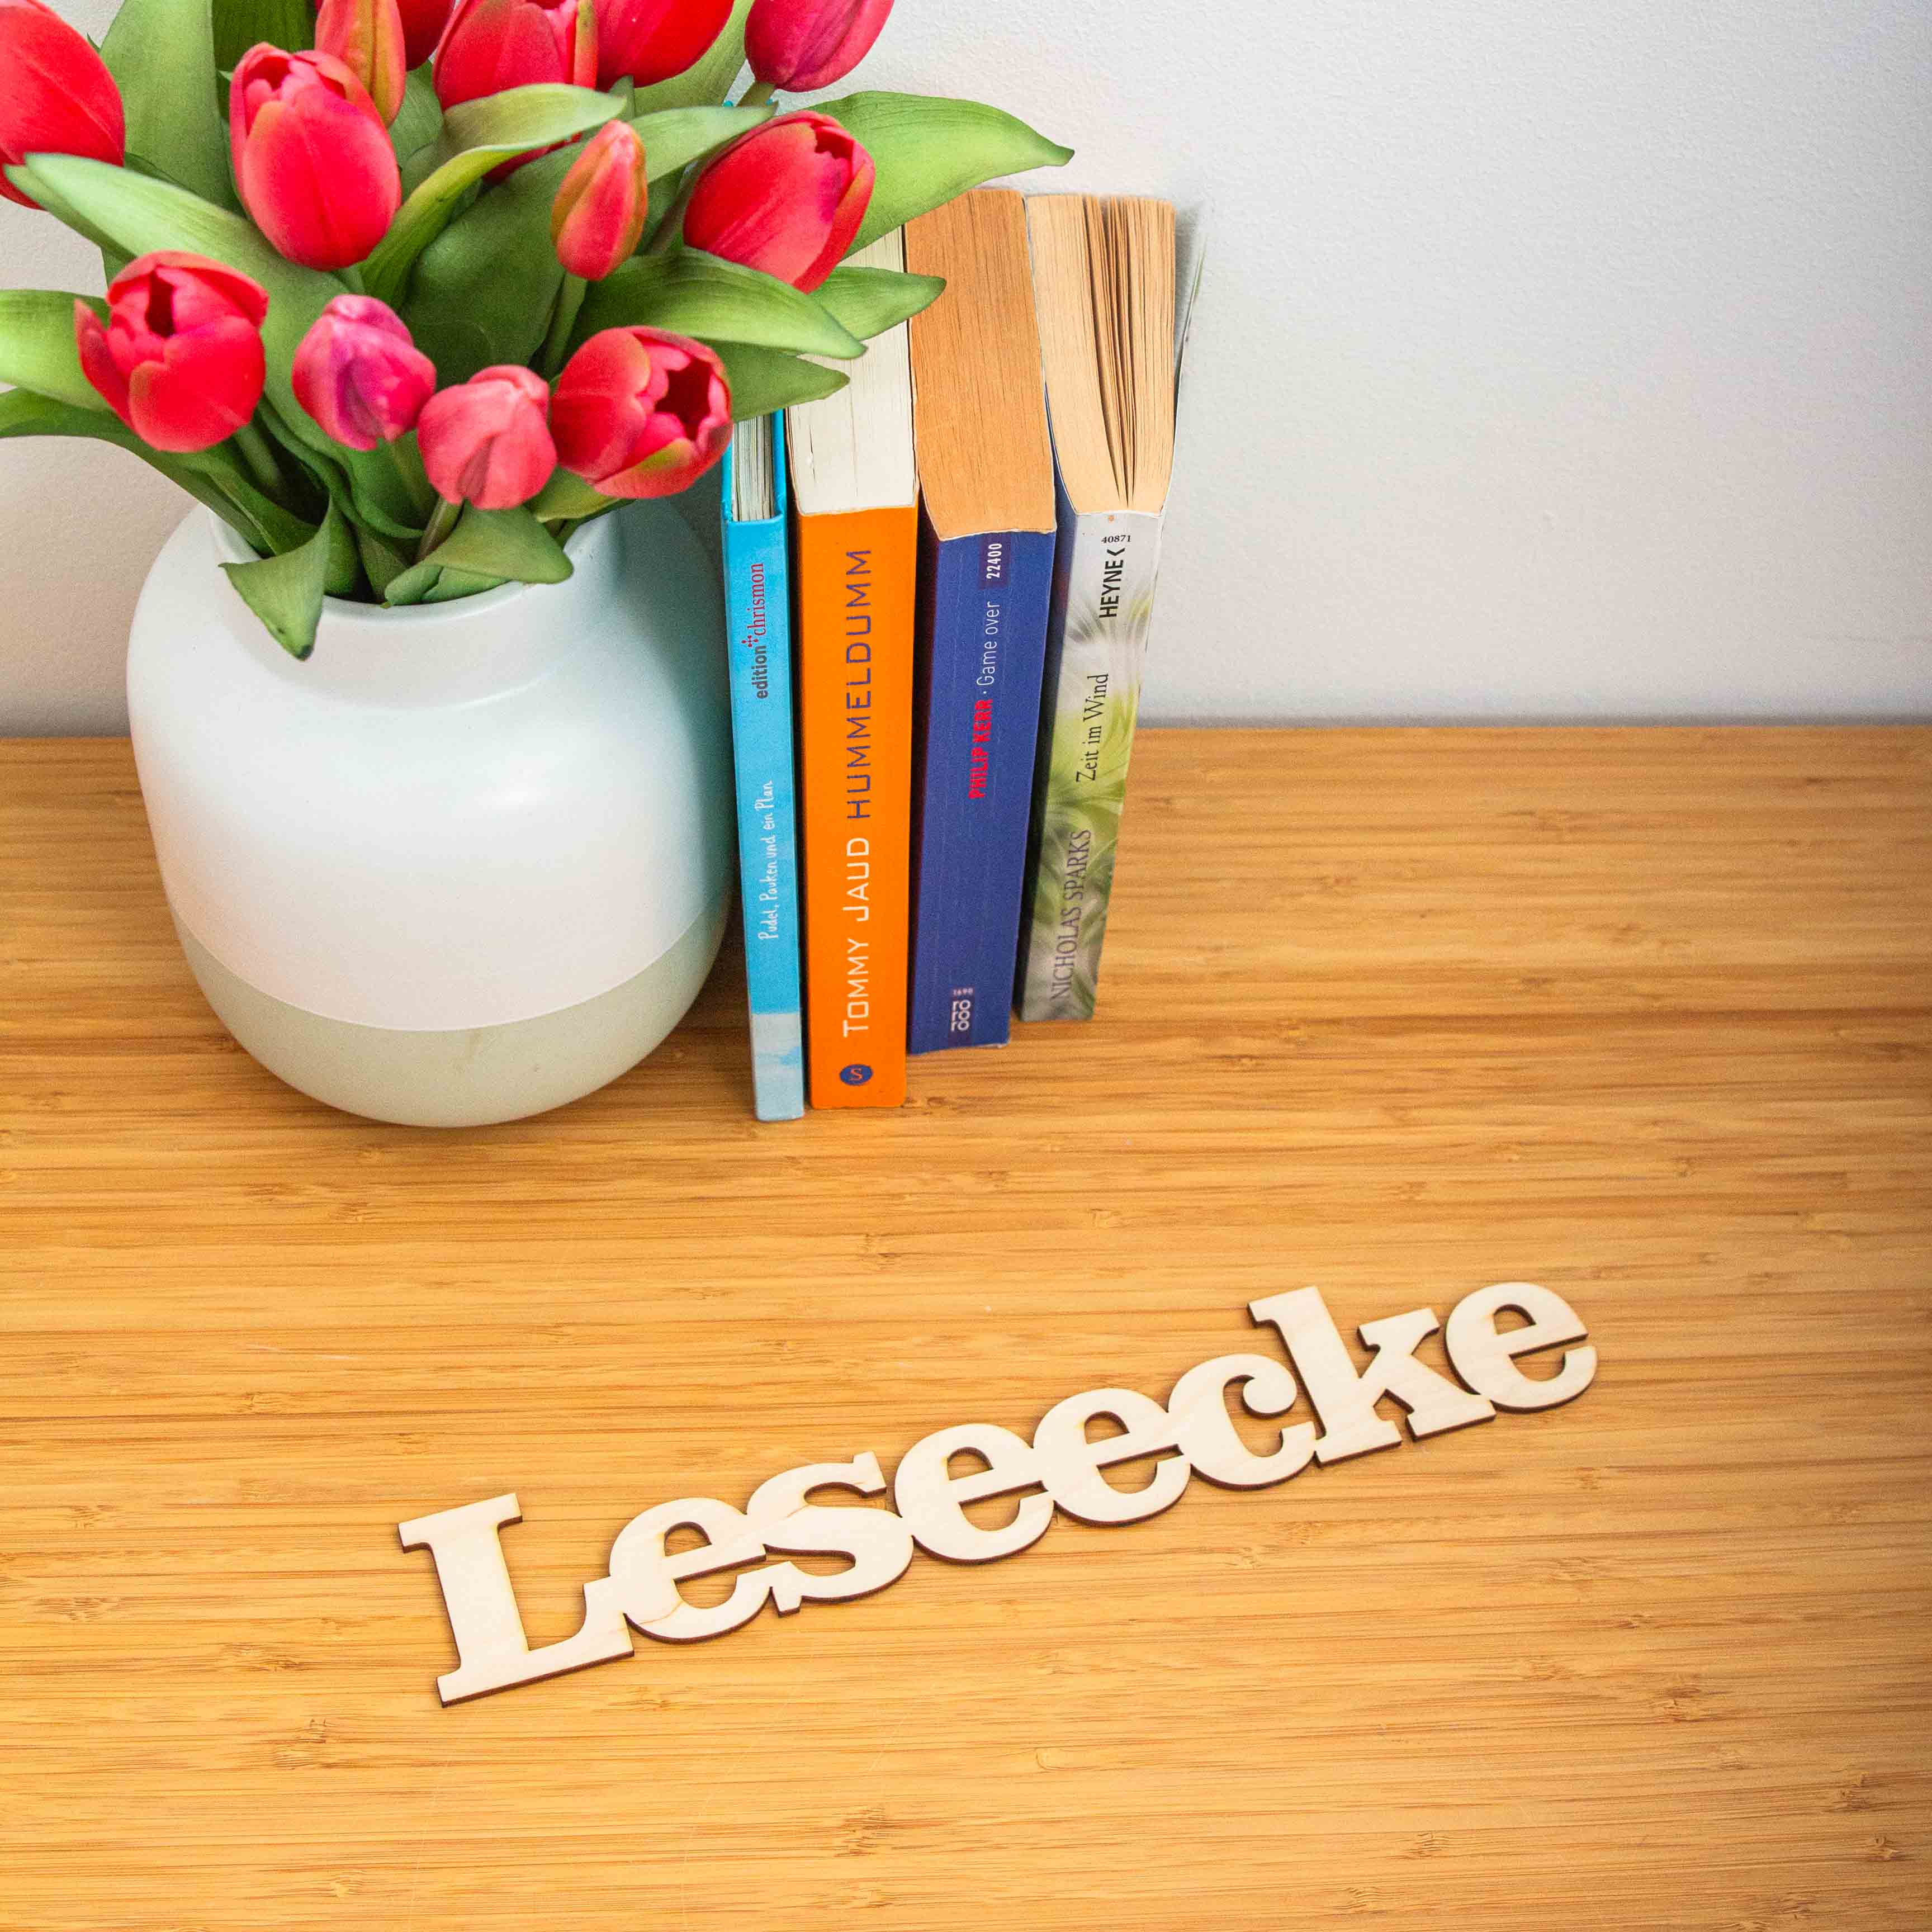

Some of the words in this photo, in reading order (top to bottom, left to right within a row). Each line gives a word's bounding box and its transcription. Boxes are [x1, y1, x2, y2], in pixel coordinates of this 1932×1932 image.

[1101, 534, 1131, 543] 40871
[986, 543, 1002, 580] 22400
[747, 562, 766, 636] chrismon
[1098, 560, 1124, 618] HEYNE
[985, 601, 1001, 635] over
[751, 645, 769, 699] edition
[845, 550, 872, 820] HUMMELDUMM
[976, 641, 997, 686] Game
[972, 699, 993, 743] KERR
[1087, 674, 1109, 723] Wind
[1088, 725, 1102, 747] im
[968, 747, 989, 799] PHILIP
[1076, 752, 1097, 783] Zeit
[754, 780, 775, 811] Plan
[763, 812, 775, 830] ein
[760, 835, 778, 859] und
[1064, 830, 1092, 902] SPARKS
[759, 860, 778, 900] Pauken
[842, 837, 870, 922] JAUD
[757, 905, 780, 940] Pudel,
[1050, 903, 1083, 1002] NICHOLAS
[842, 938, 870, 1038] TOMMY
[399, 1281, 1598, 1707] Leseecke
